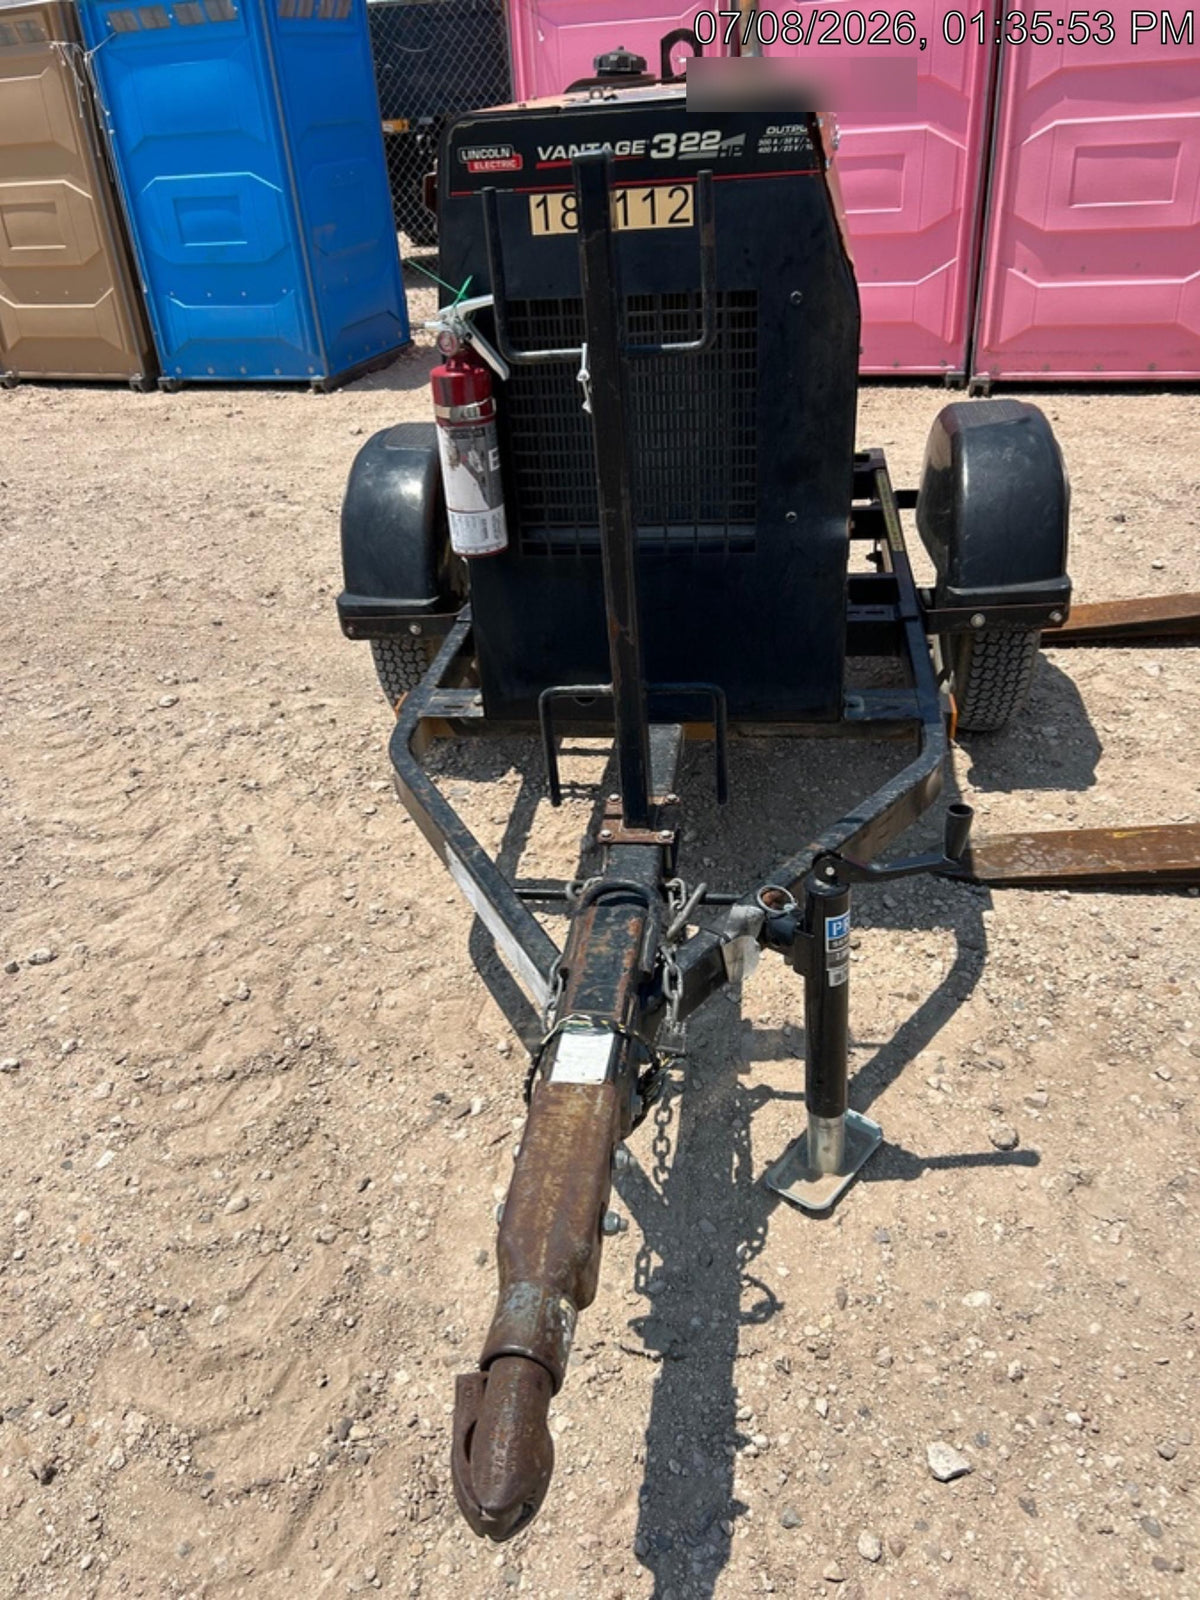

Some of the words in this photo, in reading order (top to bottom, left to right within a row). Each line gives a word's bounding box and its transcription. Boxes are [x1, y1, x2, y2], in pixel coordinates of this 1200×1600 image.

[461, 147, 511, 160] LINCOLN
[650, 130, 722, 159] 322
[473, 159, 517, 170] ELECTRIC
[535, 186, 690, 231] 18112
